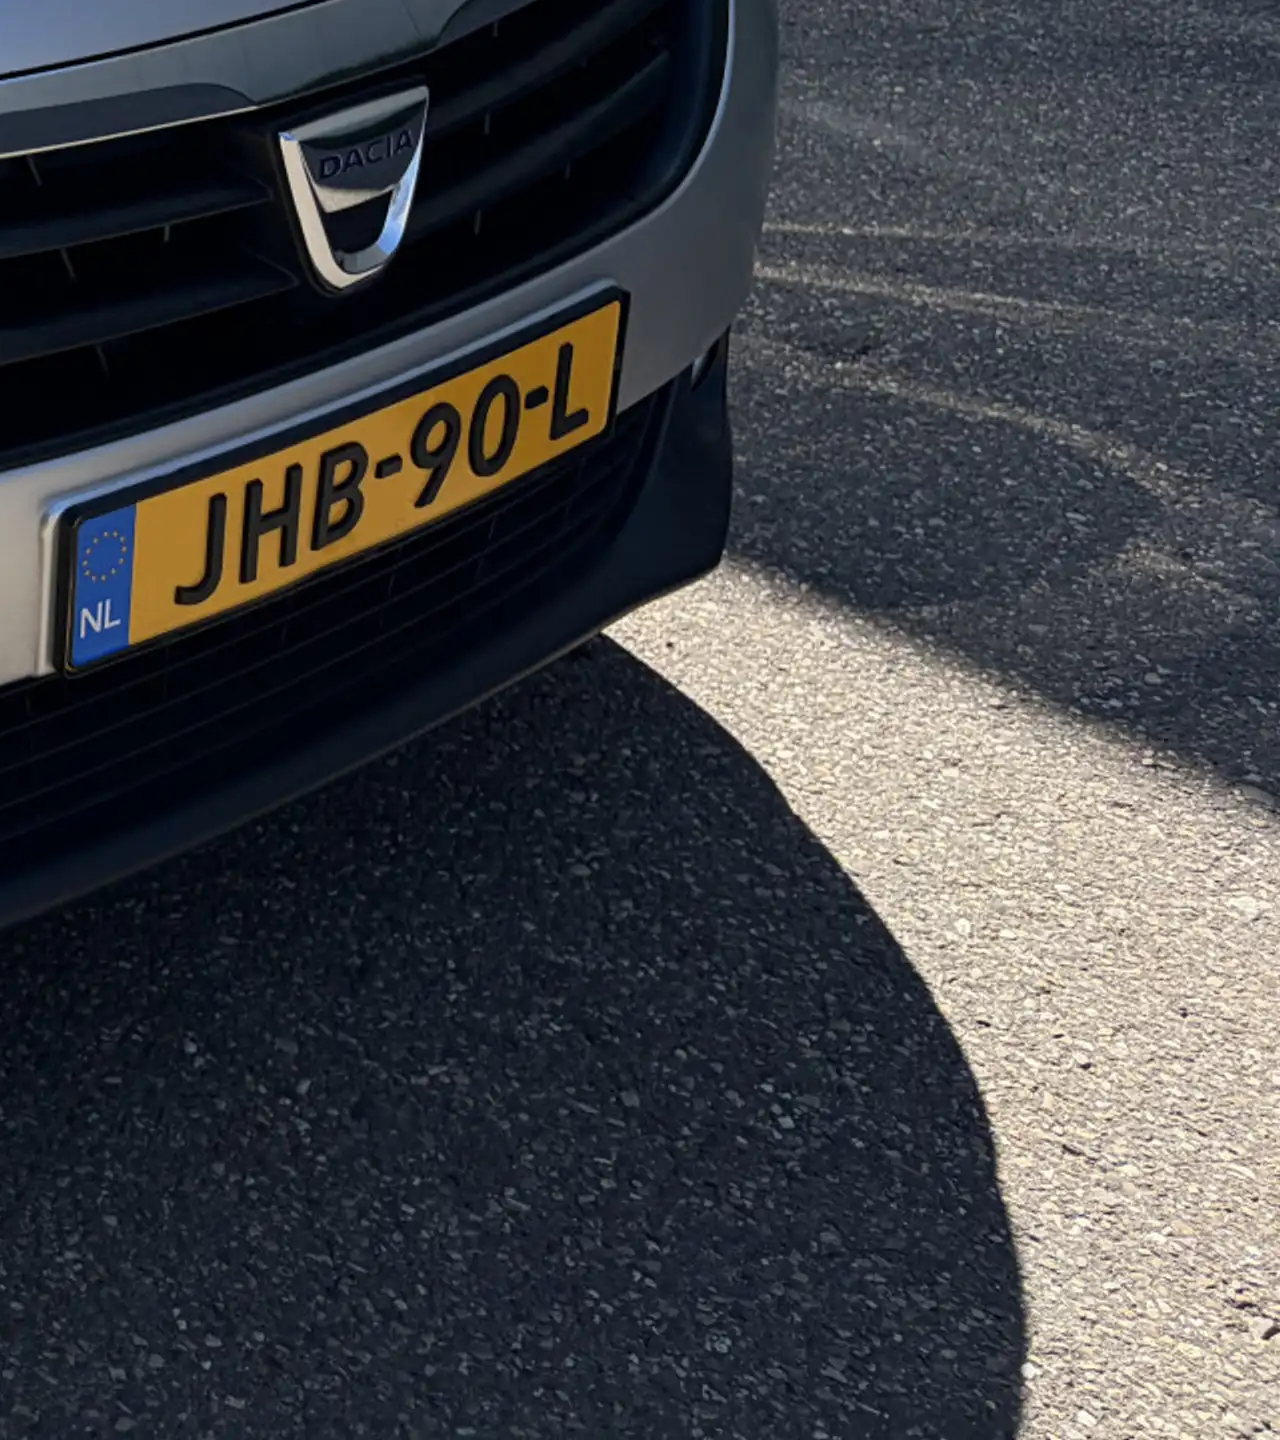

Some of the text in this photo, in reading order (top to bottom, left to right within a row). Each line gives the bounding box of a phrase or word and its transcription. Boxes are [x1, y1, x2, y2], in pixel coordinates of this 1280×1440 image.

[320, 129, 414, 178] DACIA
[174, 342, 590, 606] JHB-90-L
[79, 600, 121, 639] NL
